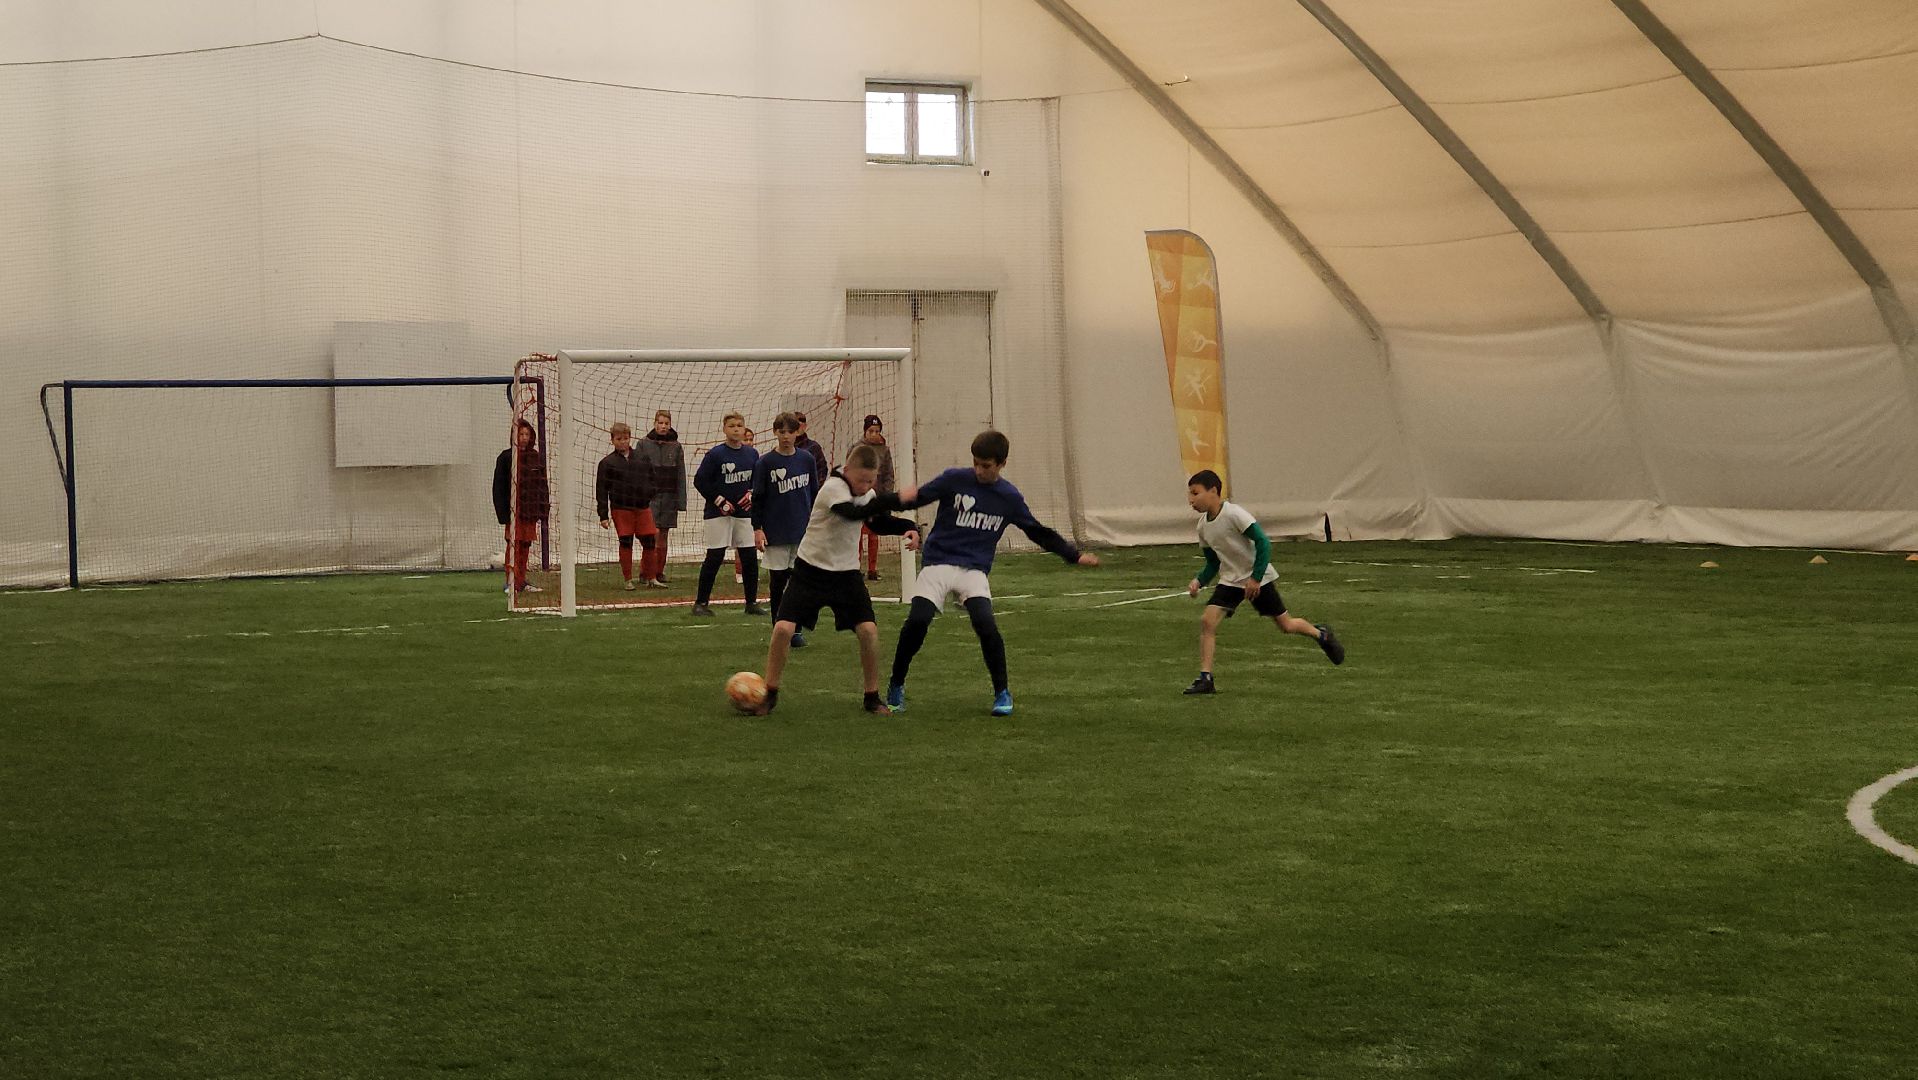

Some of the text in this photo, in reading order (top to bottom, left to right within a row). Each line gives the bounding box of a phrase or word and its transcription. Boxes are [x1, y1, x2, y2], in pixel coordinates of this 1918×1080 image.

[770, 469, 777, 483] Я
[778, 473, 810, 494] ШАТУРУ
[953, 493, 962, 510] Я
[955, 510, 1004, 532] ШАТУРУ
